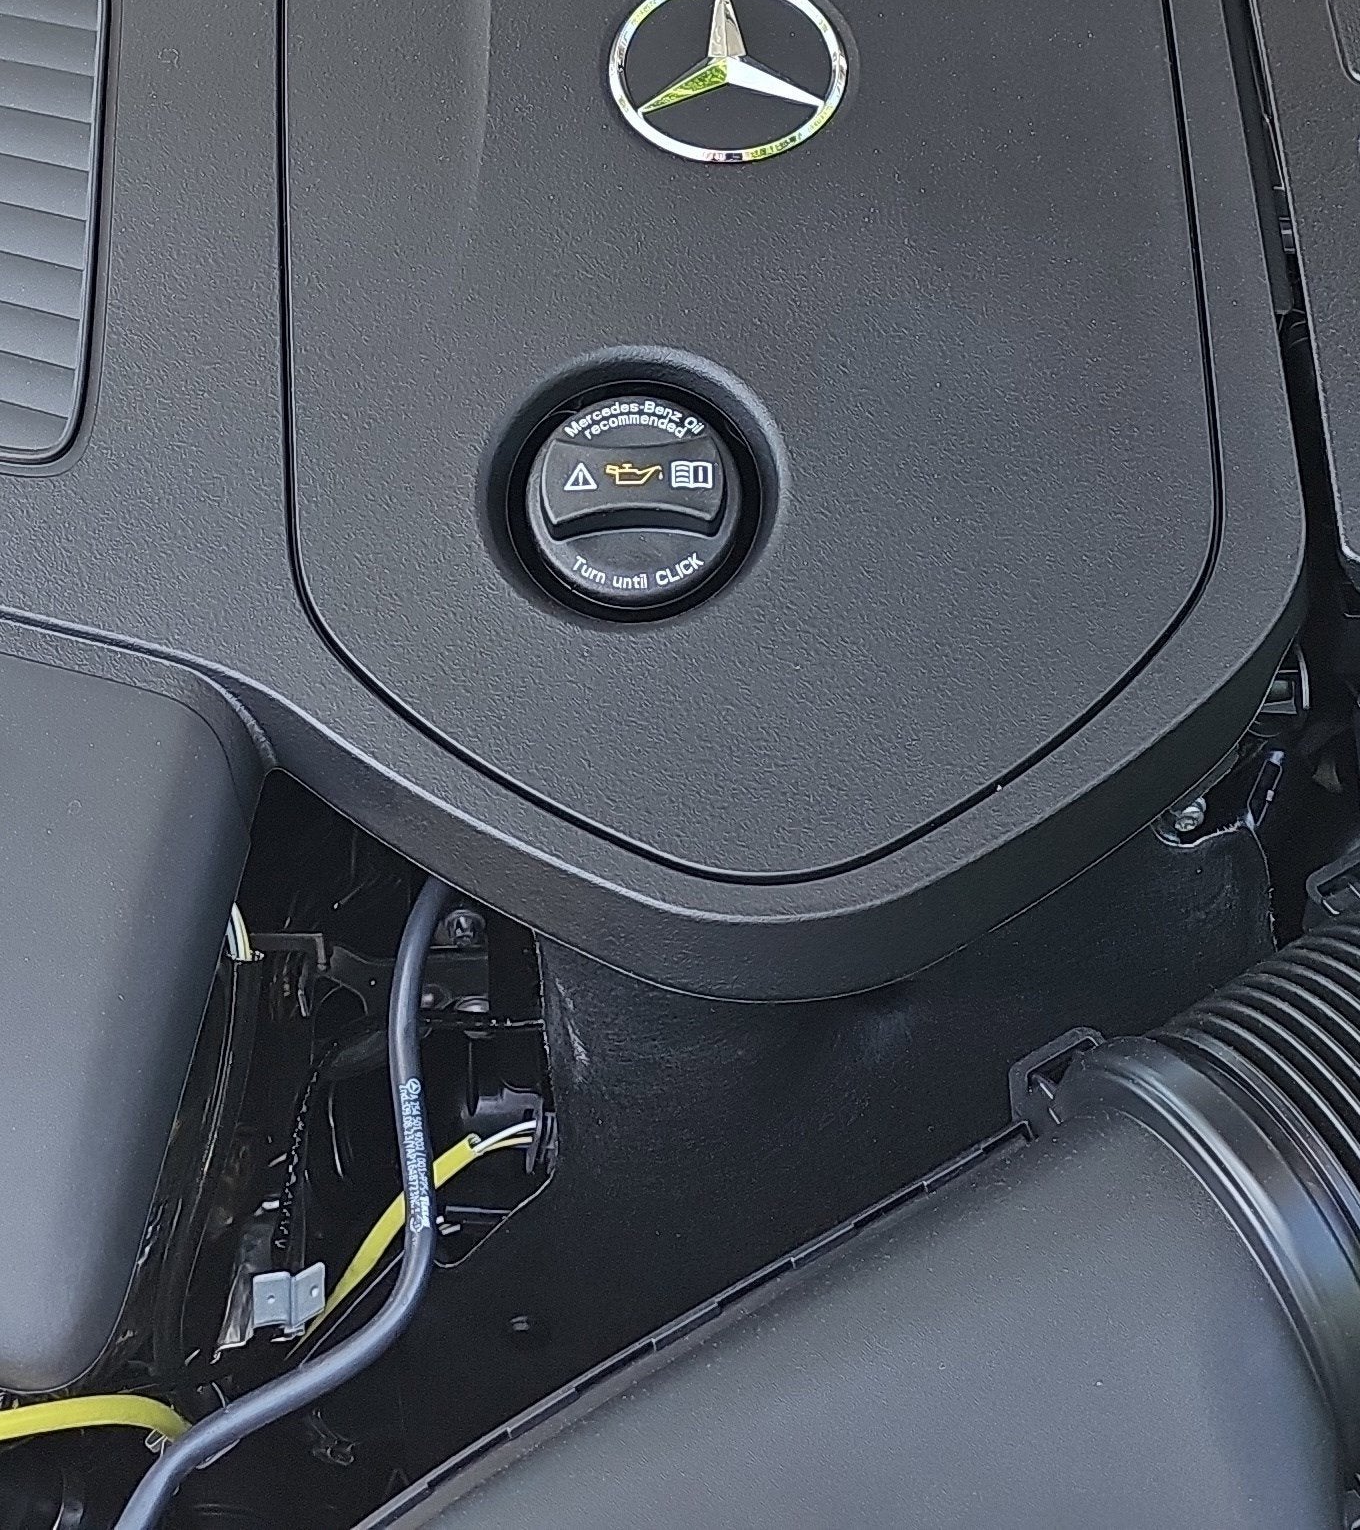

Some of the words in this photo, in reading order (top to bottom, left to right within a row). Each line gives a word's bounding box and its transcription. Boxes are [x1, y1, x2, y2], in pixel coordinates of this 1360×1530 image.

[563, 400, 683, 438] Mercedes-Benz
[684, 416, 705, 435] Oil
[584, 414, 688, 440] recommended
[571, 555, 606, 585] Turn
[612, 574, 648, 589] until
[655, 552, 705, 586] CLICK
